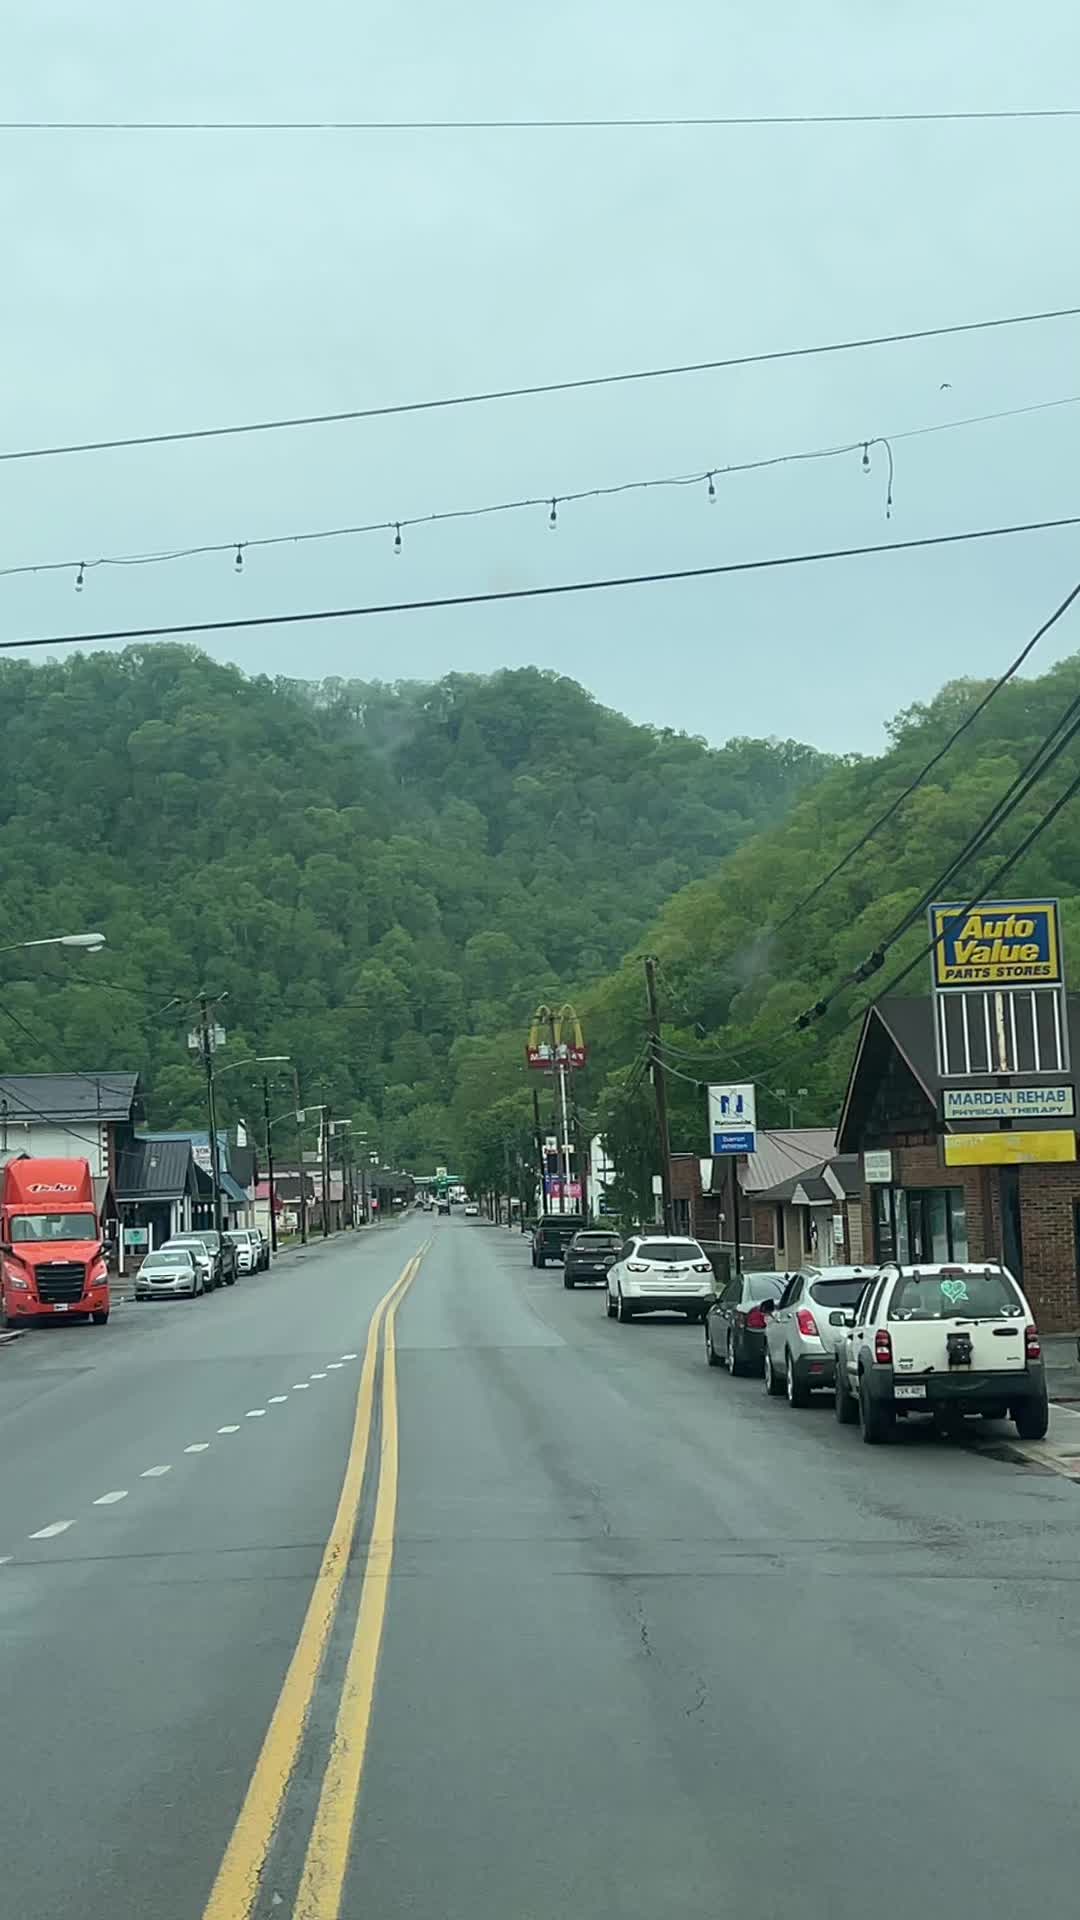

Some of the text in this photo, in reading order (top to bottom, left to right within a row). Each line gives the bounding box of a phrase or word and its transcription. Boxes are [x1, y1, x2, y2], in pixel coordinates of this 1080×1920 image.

[958, 915, 1035, 940] Auto
[953, 939, 1040, 964] Value
[945, 965, 1051, 979] PARTS STORES
[948, 1090, 1066, 1105] MARDEN REHAB
[952, 1106, 1063, 1116] PHYSICAL THERAPY
